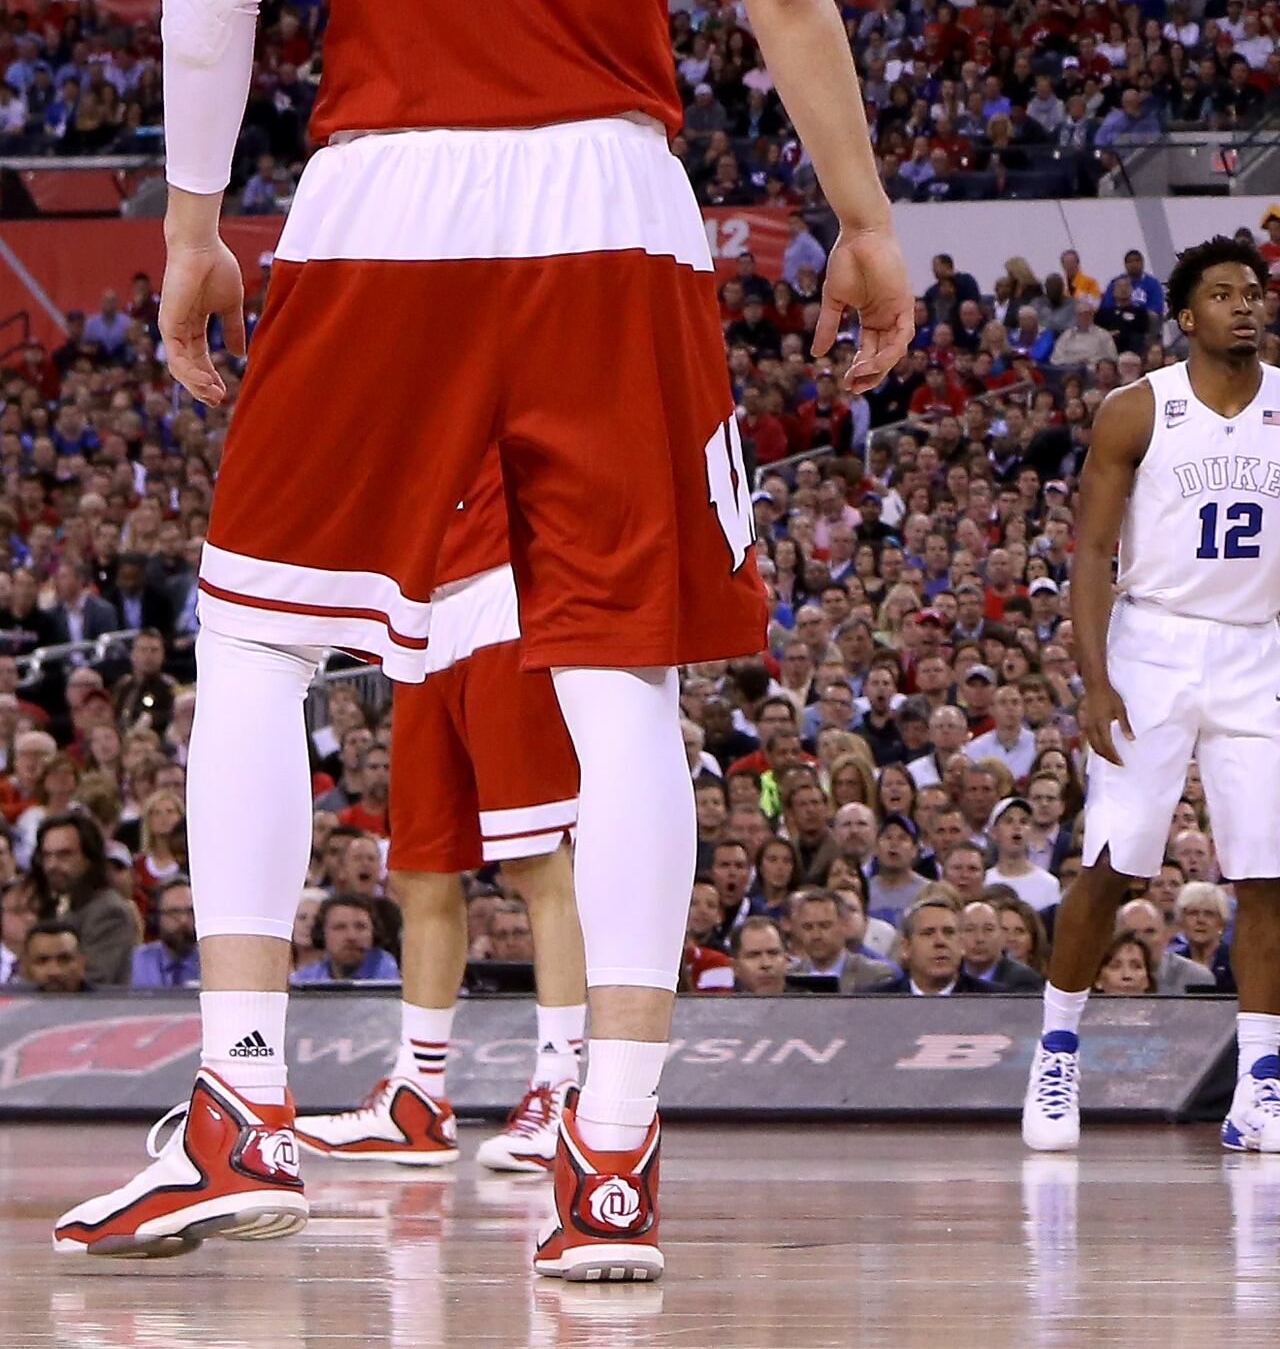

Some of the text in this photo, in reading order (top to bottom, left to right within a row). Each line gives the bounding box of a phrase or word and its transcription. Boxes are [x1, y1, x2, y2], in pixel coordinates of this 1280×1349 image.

[704, 218, 750, 259] 12
[1196, 503, 1263, 558] 12
[229, 1046, 274, 1058] adidas
